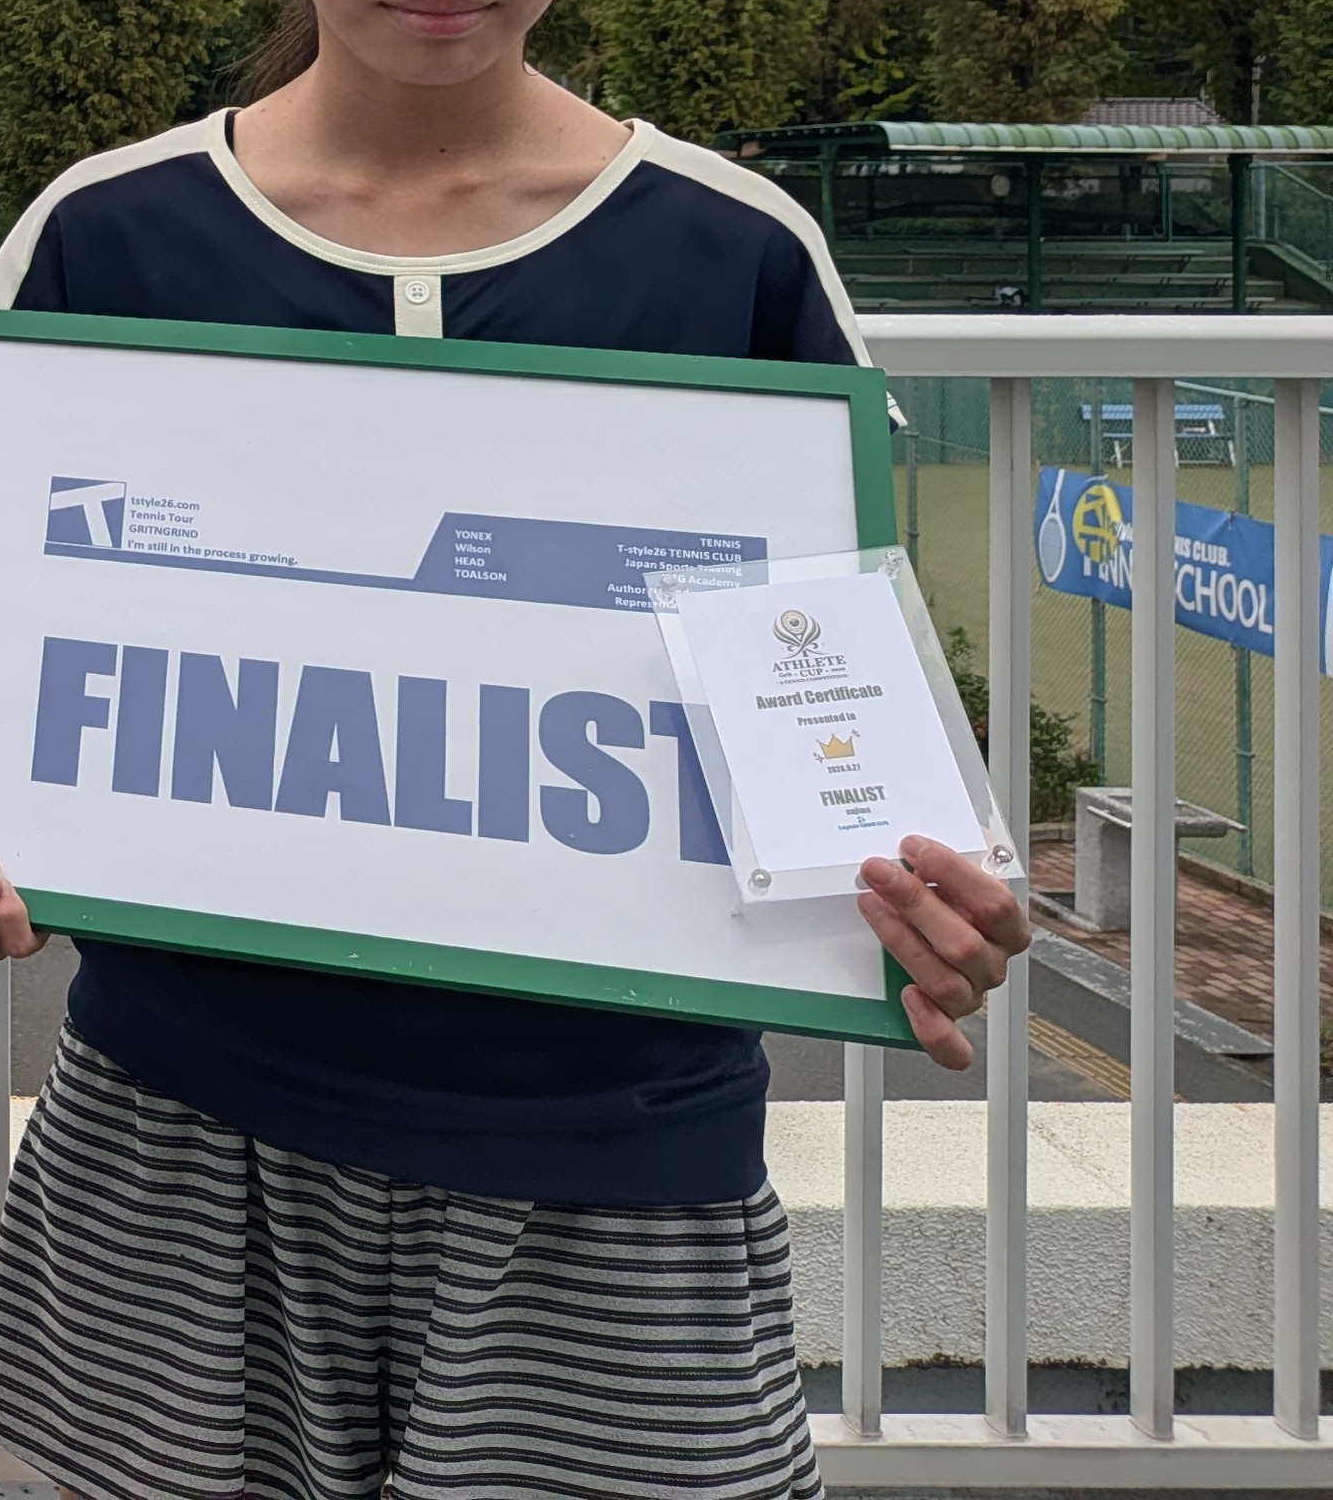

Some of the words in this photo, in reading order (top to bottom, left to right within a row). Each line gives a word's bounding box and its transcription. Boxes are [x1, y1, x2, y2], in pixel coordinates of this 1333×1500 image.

[130, 497, 201, 511] tstyle26.com
[130, 510, 166, 521] Tennis
[168, 513, 195, 524] Tour
[129, 524, 199, 539] GRITNGRIND
[454, 529, 492, 542] YONEX
[454, 543, 491, 555] Wilson
[699, 537, 741, 550] TENNIS
[127, 539, 145, 550] I'm
[147, 541, 168, 552] still
[170, 542, 181, 553] in
[183, 544, 202, 556] the
[204, 547, 247, 560] process
[249, 553, 299, 566] growing.
[617, 544, 668, 557] T-style26
[668, 548, 710, 560] TENNIS
[711, 552, 742, 564] CLUB
[1192, 540, 1231, 568] CLUB.
[454, 556, 485, 568] HEAD
[624, 558, 657, 570] Japan
[454, 569, 507, 582] TOALSON
[688, 575, 742, 589] Academy
[1174, 560, 1273, 634] CHOOL
[771, 655, 847, 672] ATHLETE
[799, 667, 824, 677] CUP
[755, 691, 804, 710] Award
[803, 684, 884, 705] Certificate
[796, 712, 846, 726] Presented
[846, 711, 857, 721] to
[30, 635, 732, 867] FINALIST
[819, 785, 886, 807] FINALIST
